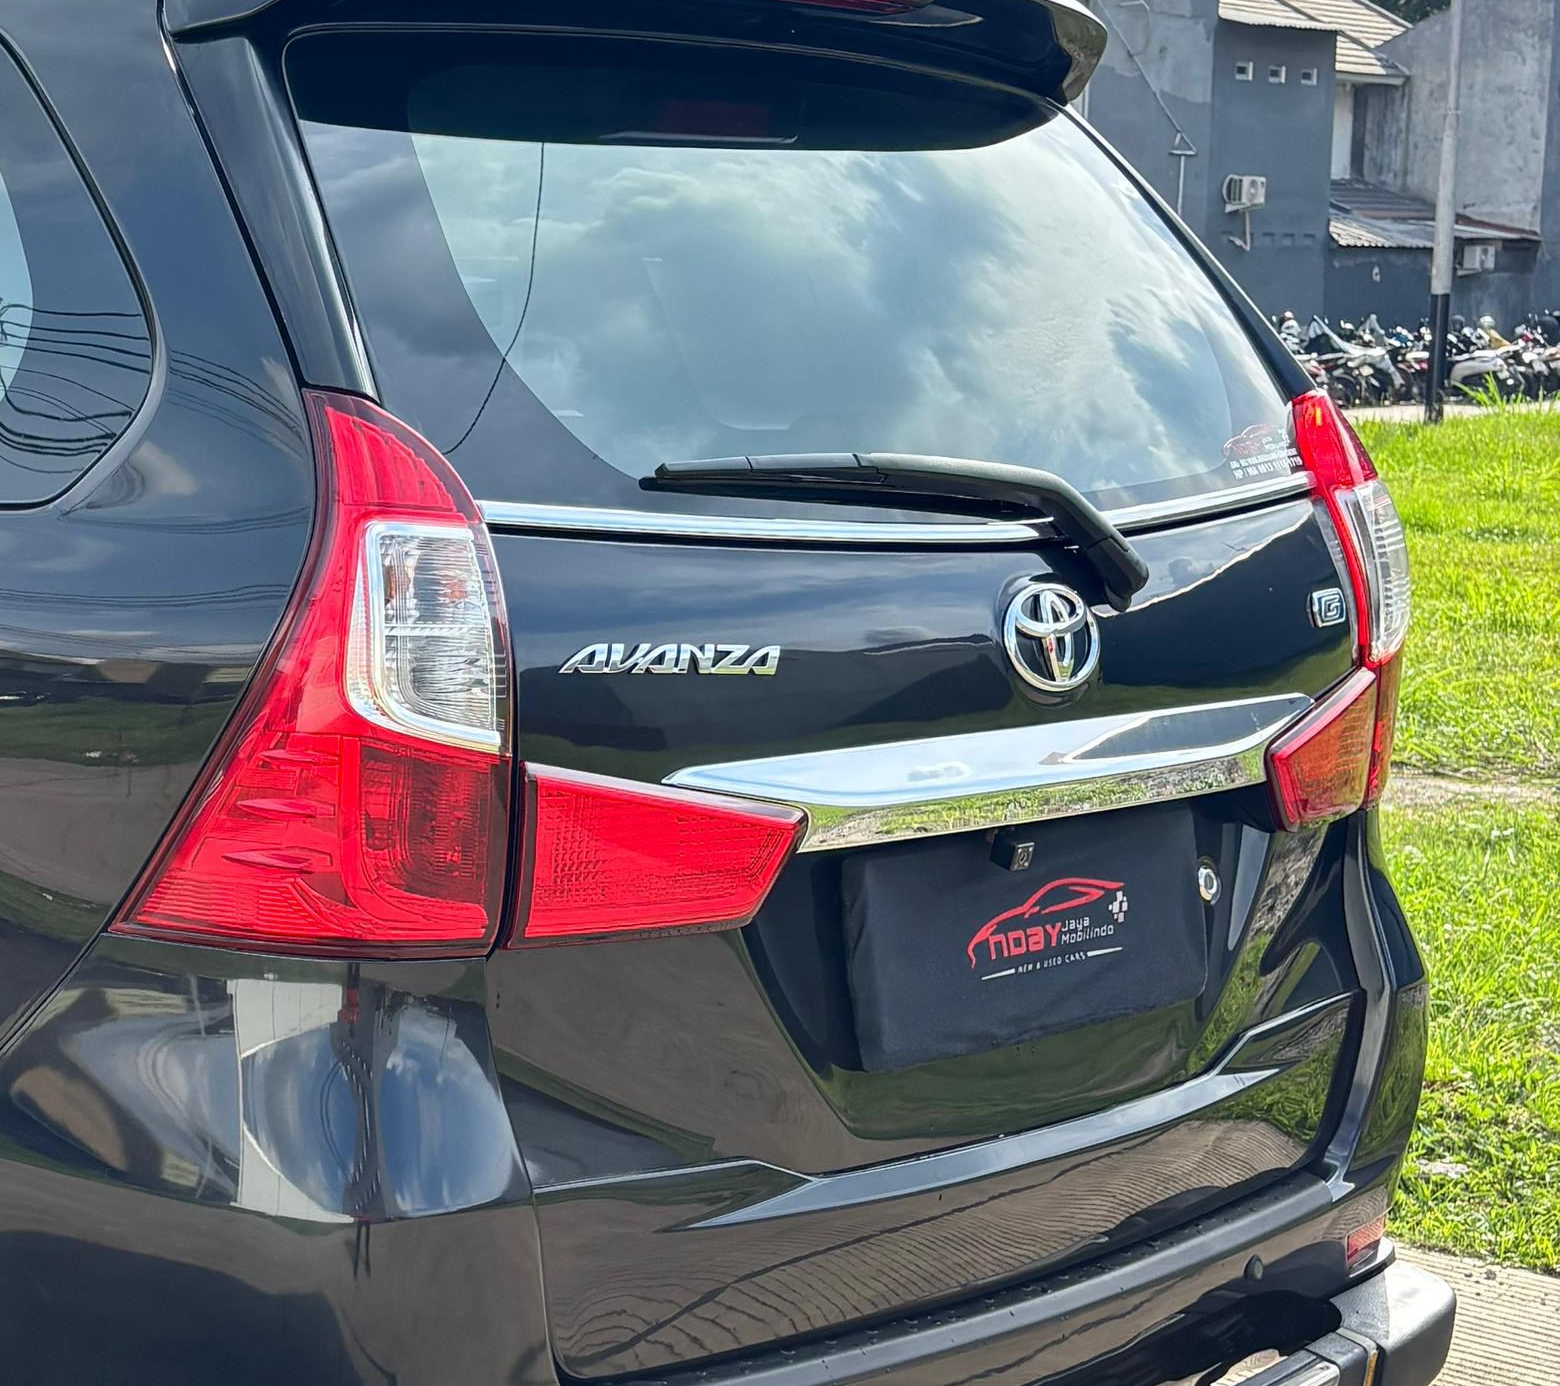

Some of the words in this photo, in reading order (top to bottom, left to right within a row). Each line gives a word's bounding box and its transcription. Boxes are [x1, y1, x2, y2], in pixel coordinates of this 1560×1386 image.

[558, 643, 781, 675] AVANZA
[1061, 917, 1090, 931] Jaya
[1061, 924, 1114, 945] Mobilindo
[1043, 956, 1062, 967] USED
[1065, 951, 1086, 963] CARS
